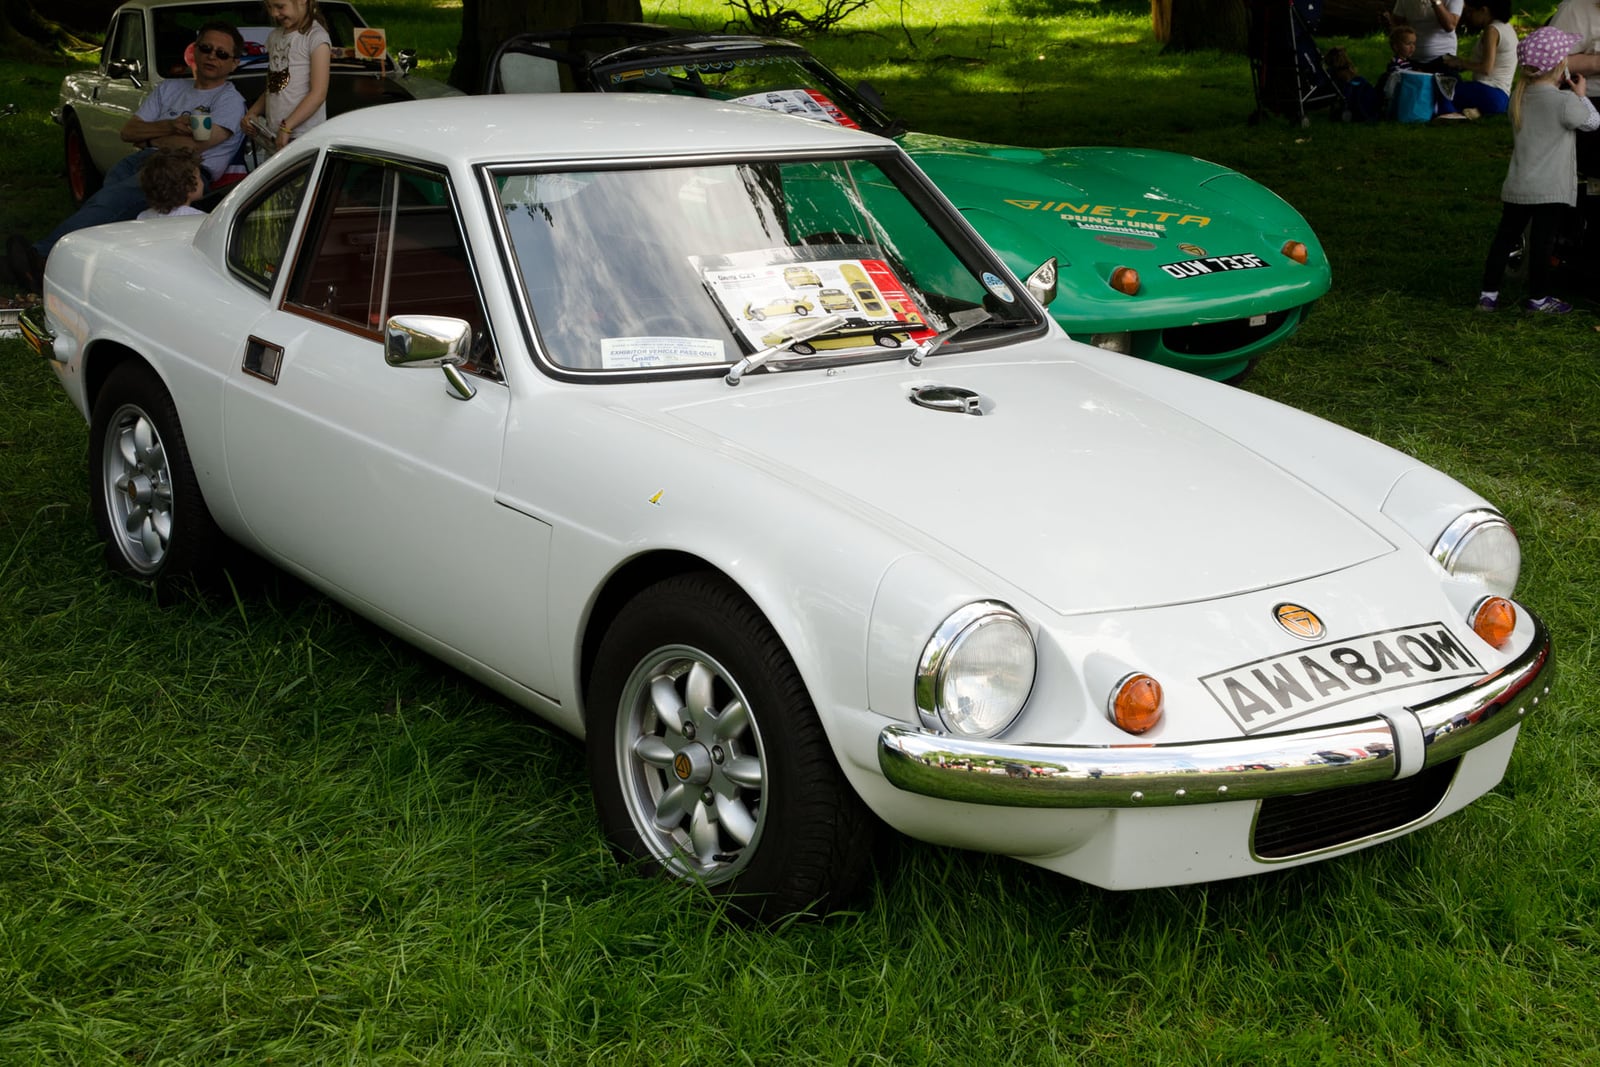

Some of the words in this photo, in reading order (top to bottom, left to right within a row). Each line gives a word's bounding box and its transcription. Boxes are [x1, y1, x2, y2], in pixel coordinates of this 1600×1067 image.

[1002, 199, 1212, 228] GINETTA
[1060, 213, 1167, 232] DUNCTUNE
[1205, 253, 1263, 271] 733F
[1222, 629, 1476, 723] AWA840M
